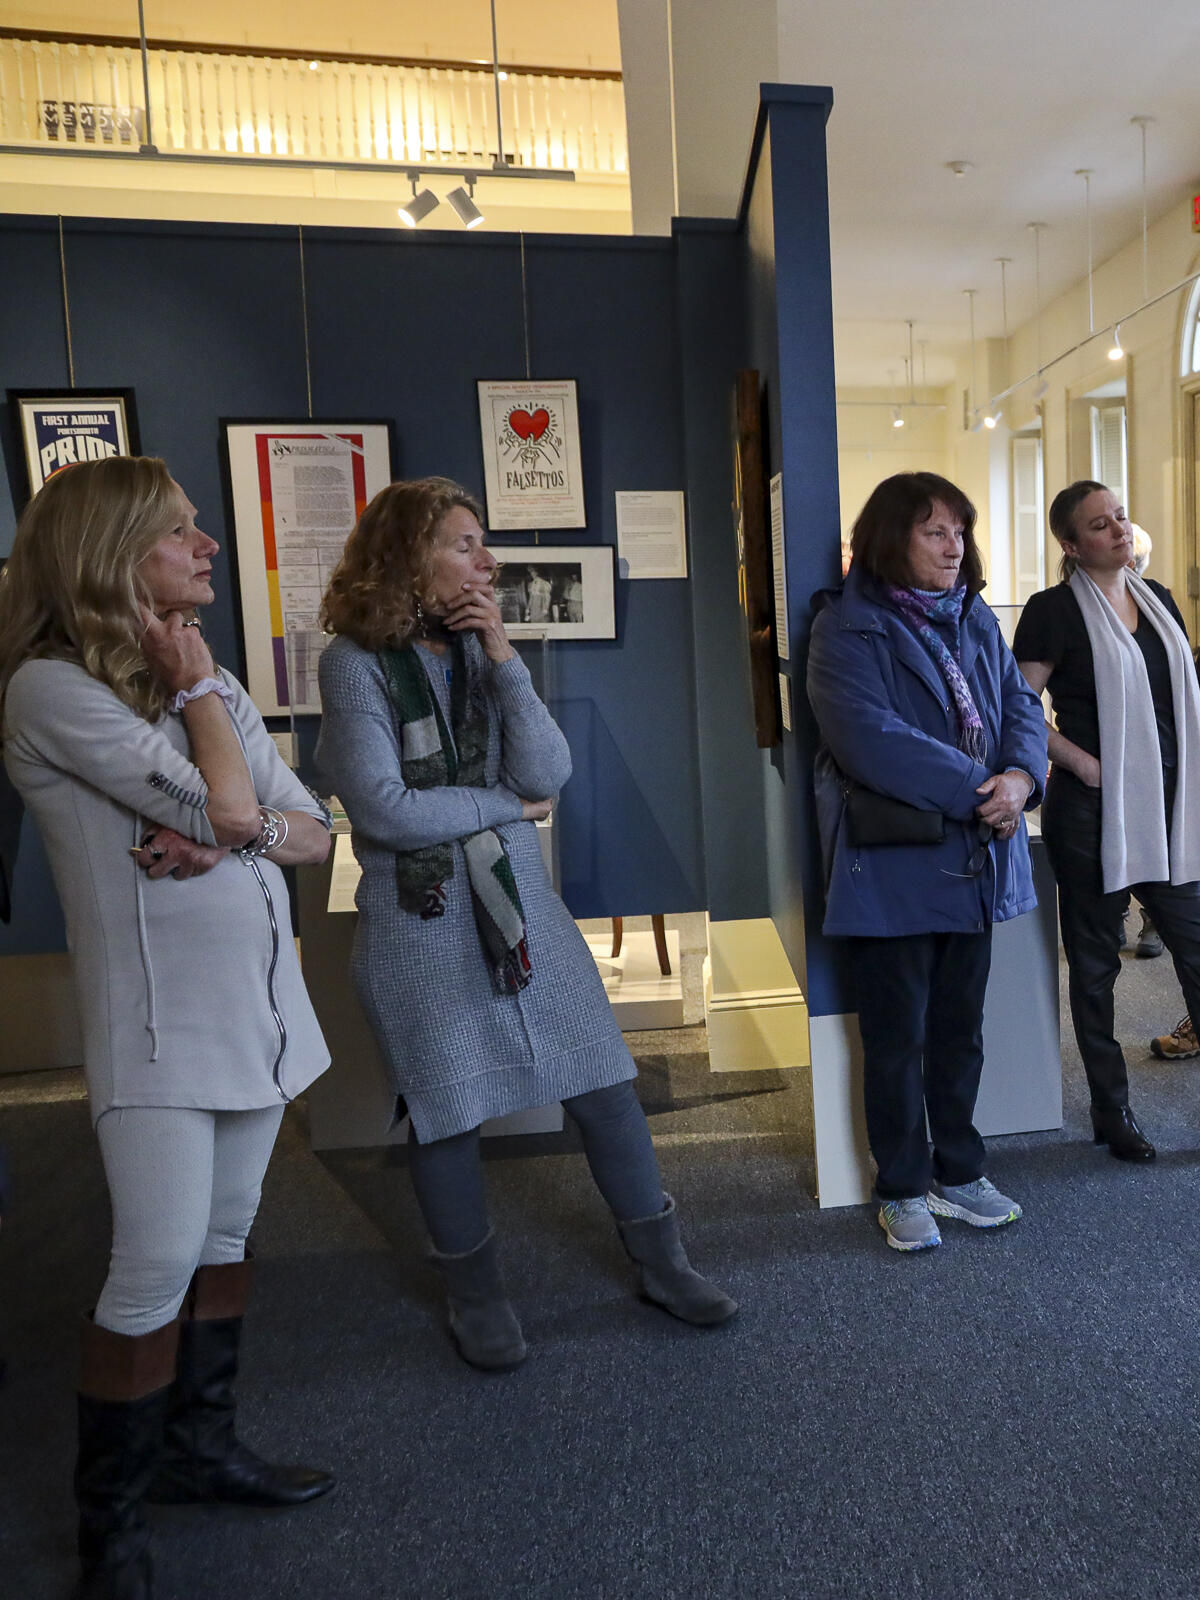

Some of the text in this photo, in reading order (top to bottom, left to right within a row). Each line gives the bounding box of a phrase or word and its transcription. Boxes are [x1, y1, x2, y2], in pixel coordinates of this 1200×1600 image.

[44, 103, 66, 113] TH
[42, 414, 110, 426] FIRST ANNUAL
[506, 470, 564, 490] FALSETTOS
